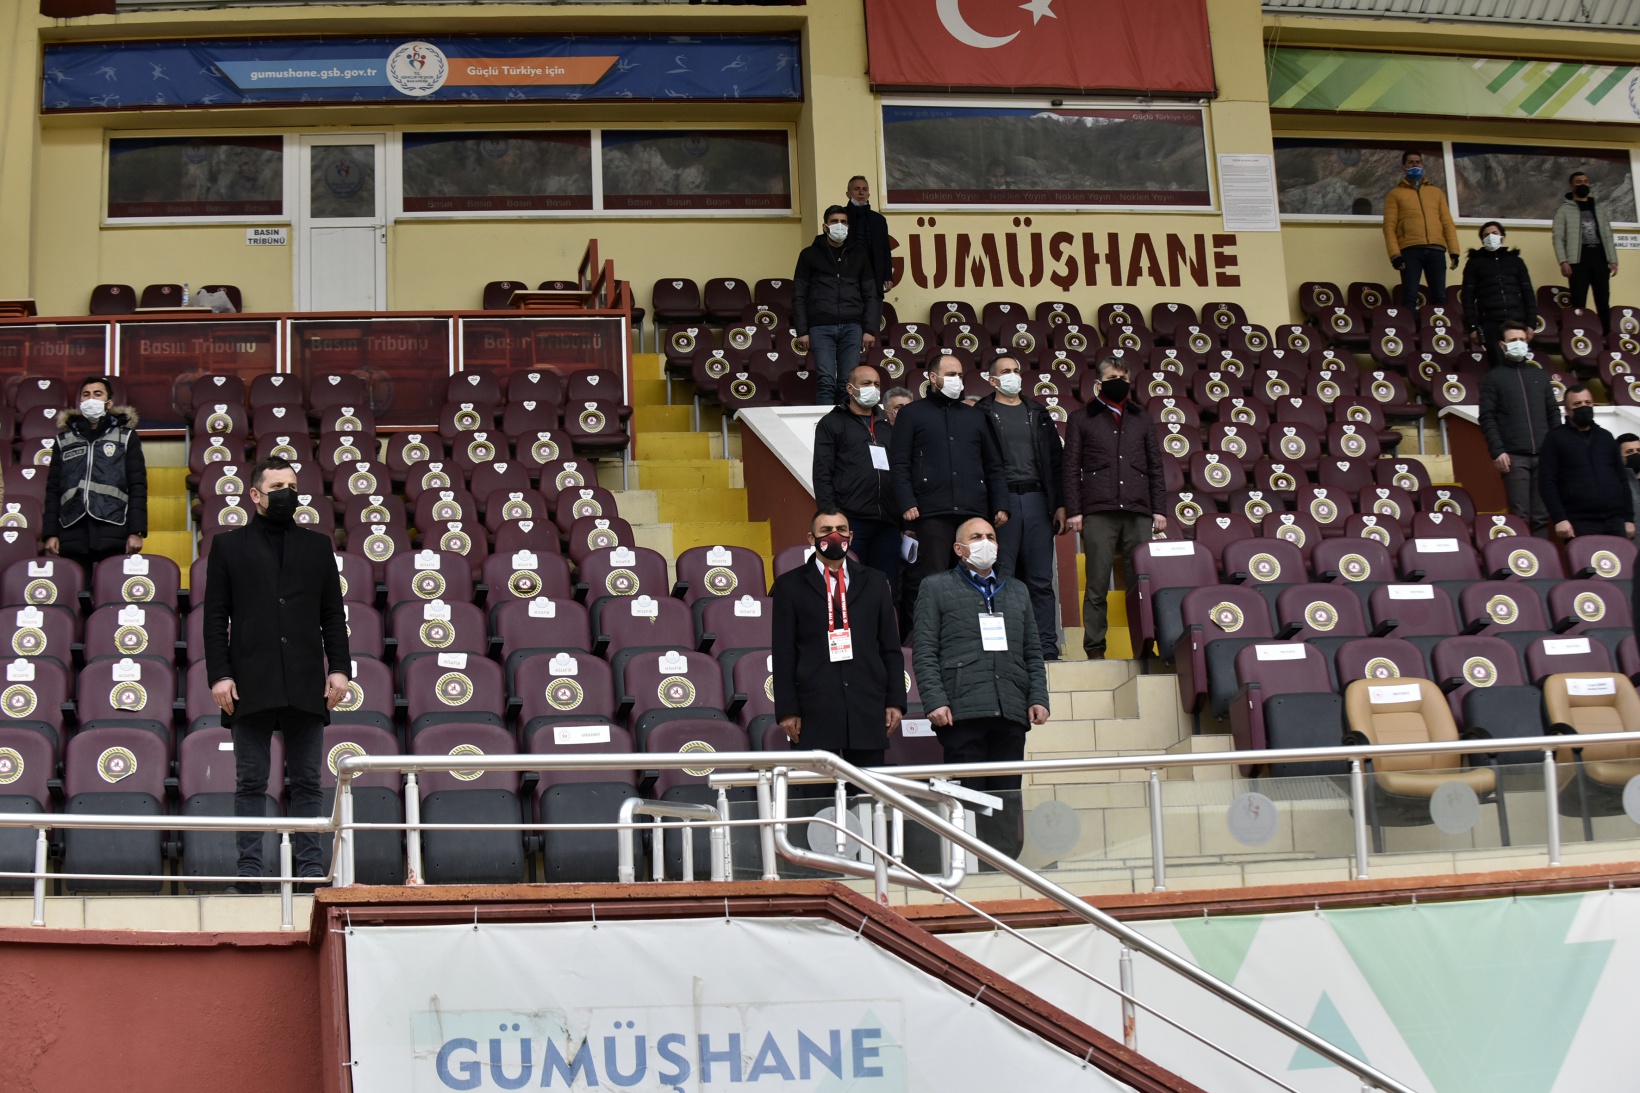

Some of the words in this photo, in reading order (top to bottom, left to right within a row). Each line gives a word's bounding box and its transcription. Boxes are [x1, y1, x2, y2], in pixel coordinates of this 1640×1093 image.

[251, 67, 377, 80] gumushane.gsb.gov.tr
[467, 66, 499, 77] Güçlü
[502, 66, 542, 77] Türkiye
[545, 66, 565, 77] için
[1132, 113, 1153, 122] Güçlü
[922, 192, 952, 200] Naklen
[1055, 193, 1085, 201] Naklen
[1088, 193, 1111, 202] Yayın
[1119, 193, 1149, 201] Naklen
[1152, 194, 1175, 202] Yayın
[248, 237, 285, 245] TRİBÜNÜ
[140, 339, 186, 354] Basın
[192, 338, 256, 353] Tribünü
[311, 336, 358, 351] Basın
[365, 335, 429, 350] Tribünü
[435, 1020, 885, 1093] GÜMÜŞHANE
